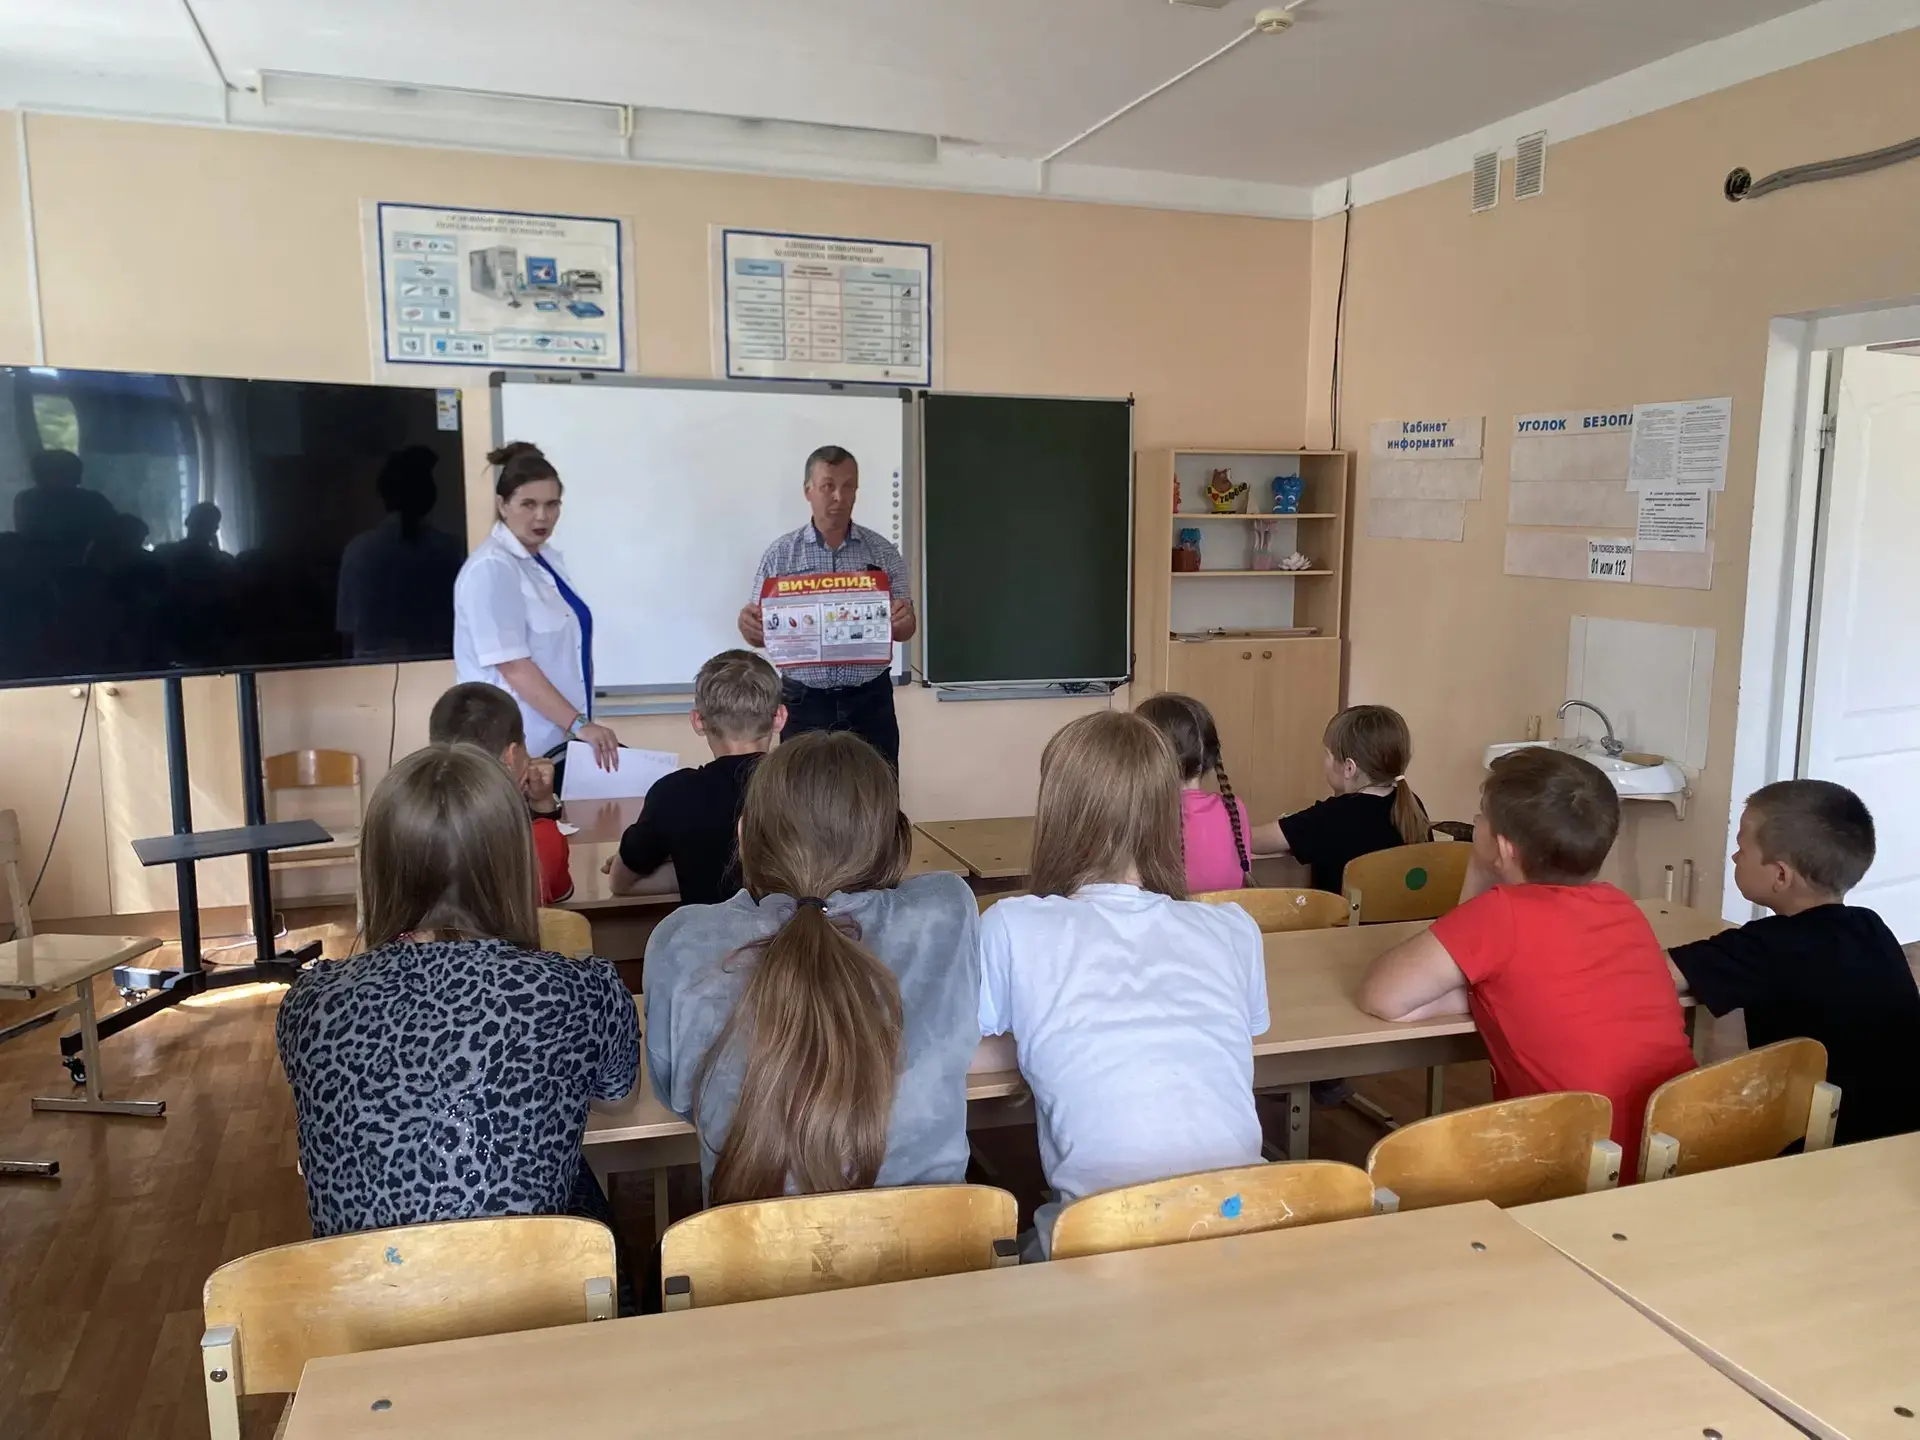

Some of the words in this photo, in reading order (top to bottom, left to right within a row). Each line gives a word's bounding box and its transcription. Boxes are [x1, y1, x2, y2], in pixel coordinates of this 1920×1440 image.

[1402, 421, 1447, 433] Кабинет
[1518, 419, 1567, 432] УГОЛОК
[1388, 437, 1454, 451] информатик
[1591, 558, 1598, 574] 01
[1600, 562, 1613, 575] или
[1614, 559, 1626, 576] 112
[777, 575, 876, 592] ВИЧ/СПИД:
